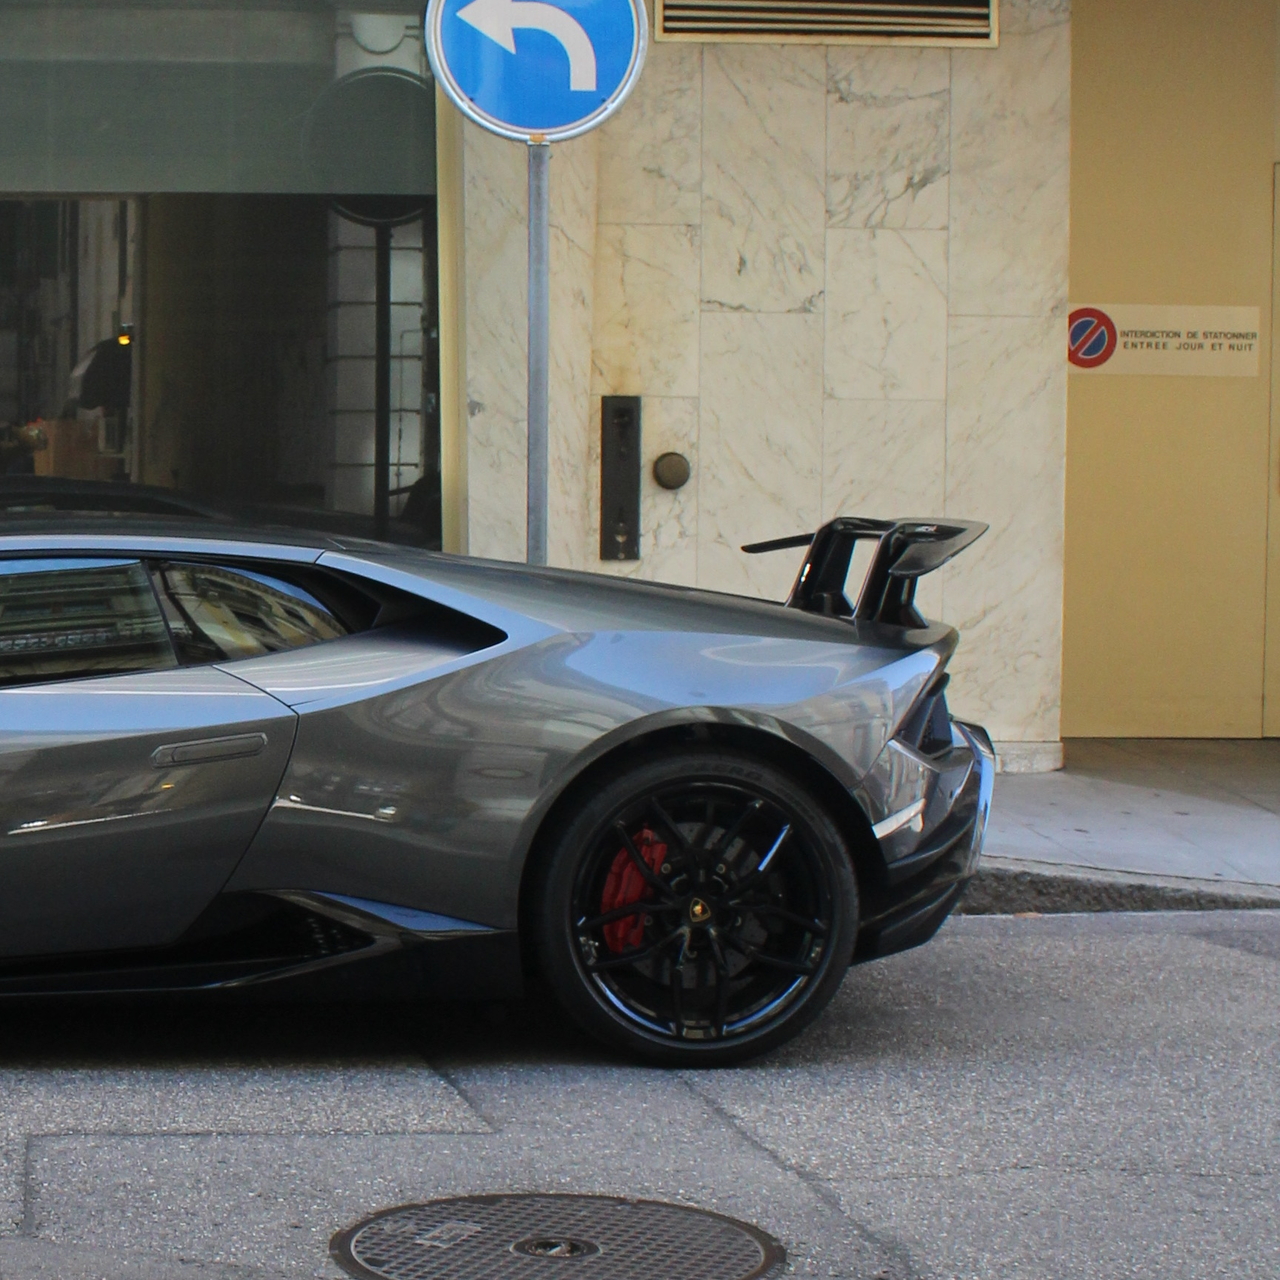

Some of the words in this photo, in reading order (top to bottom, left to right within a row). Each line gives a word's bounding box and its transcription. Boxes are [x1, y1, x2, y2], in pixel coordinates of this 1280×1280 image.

[1120, 330, 1181, 339] INTERDICTION
[1186, 331, 1199, 339] DE
[1202, 331, 1258, 340] STATIONNER
[1176, 342, 1204, 350] JOUR
[1211, 342, 1223, 351] ET
[1228, 343, 1254, 351] NUIT
